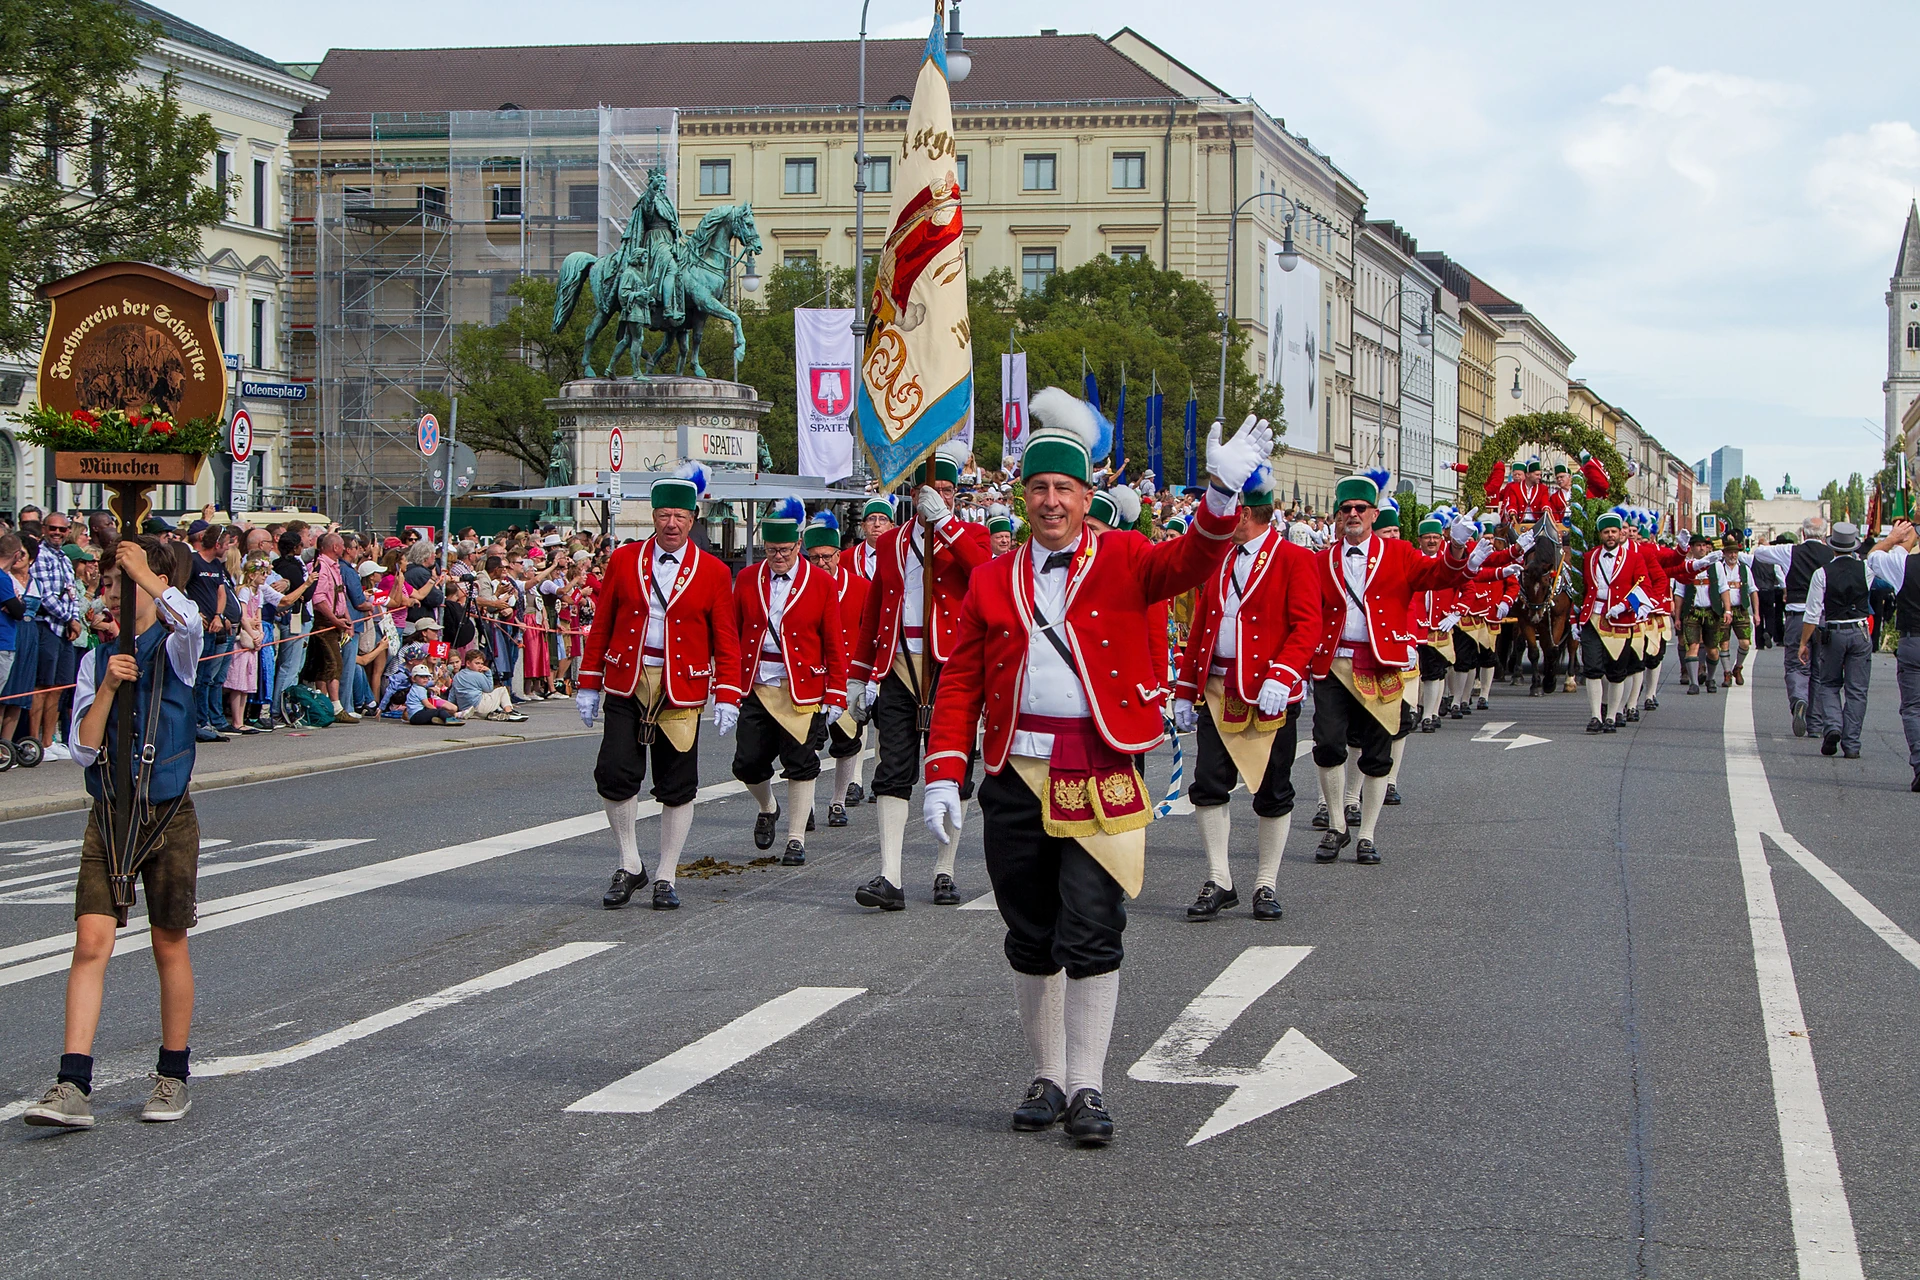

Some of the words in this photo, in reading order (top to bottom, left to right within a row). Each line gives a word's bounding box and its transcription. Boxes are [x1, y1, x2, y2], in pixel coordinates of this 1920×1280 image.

[50, 304, 120, 380] Fachverein
[122, 298, 150, 317] der
[153, 304, 207, 382] Schäffler
[245, 383, 303, 398] Odeonsplatz
[709, 434, 743, 456] SPATEN
[79, 457, 160, 477] München
